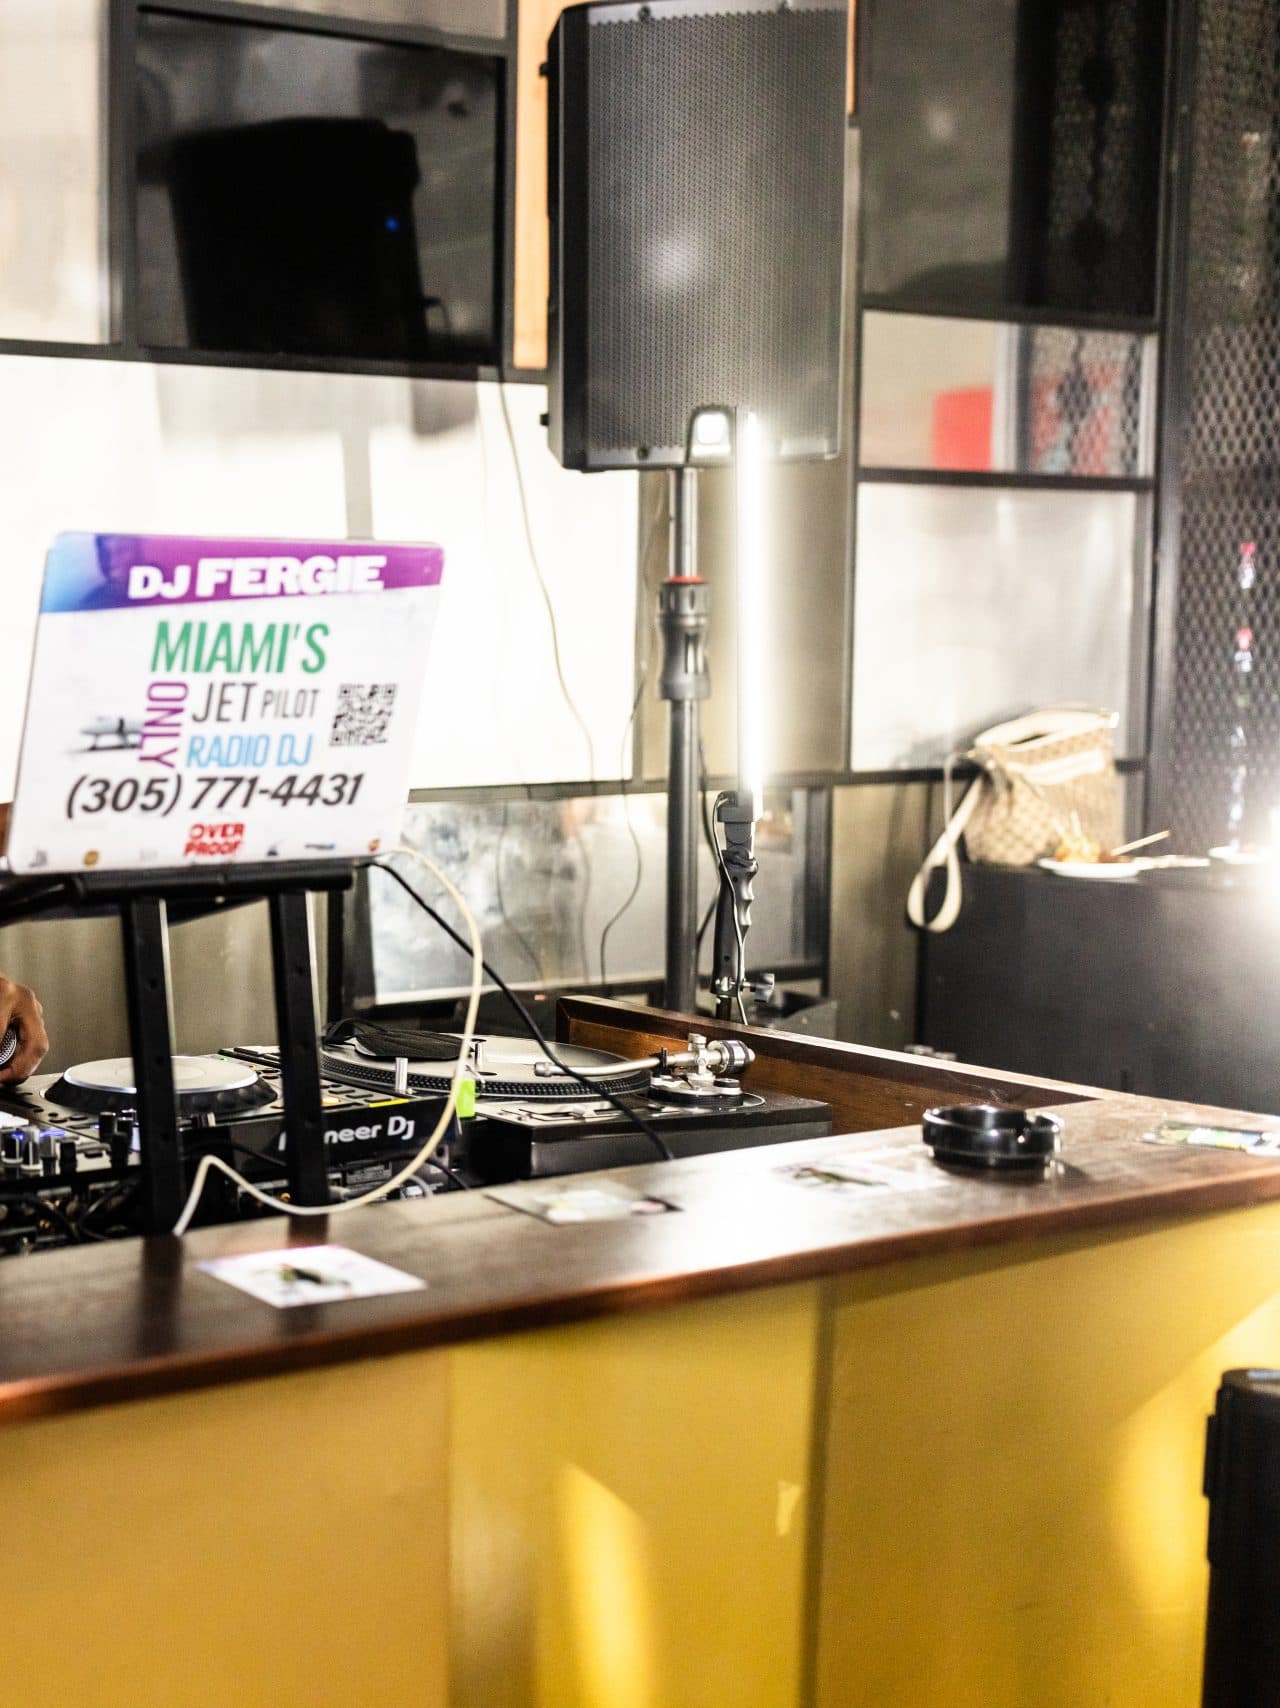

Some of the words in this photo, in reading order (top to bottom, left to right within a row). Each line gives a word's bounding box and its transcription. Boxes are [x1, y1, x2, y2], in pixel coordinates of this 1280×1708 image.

[128, 565, 191, 599] DJ
[195, 555, 387, 597] FERGIE
[151, 621, 330, 673] MIAMI'S
[192, 682, 257, 722] JET
[261, 689, 320, 718] PILOT
[138, 682, 188, 768] ONLY
[186, 734, 270, 768] RADIO
[276, 733, 313, 766] DJ
[67, 774, 182, 818] (305)
[190, 773, 365, 809] 771-4431
[184, 840, 241, 856] PROOF
[190, 823, 244, 839] OVER
